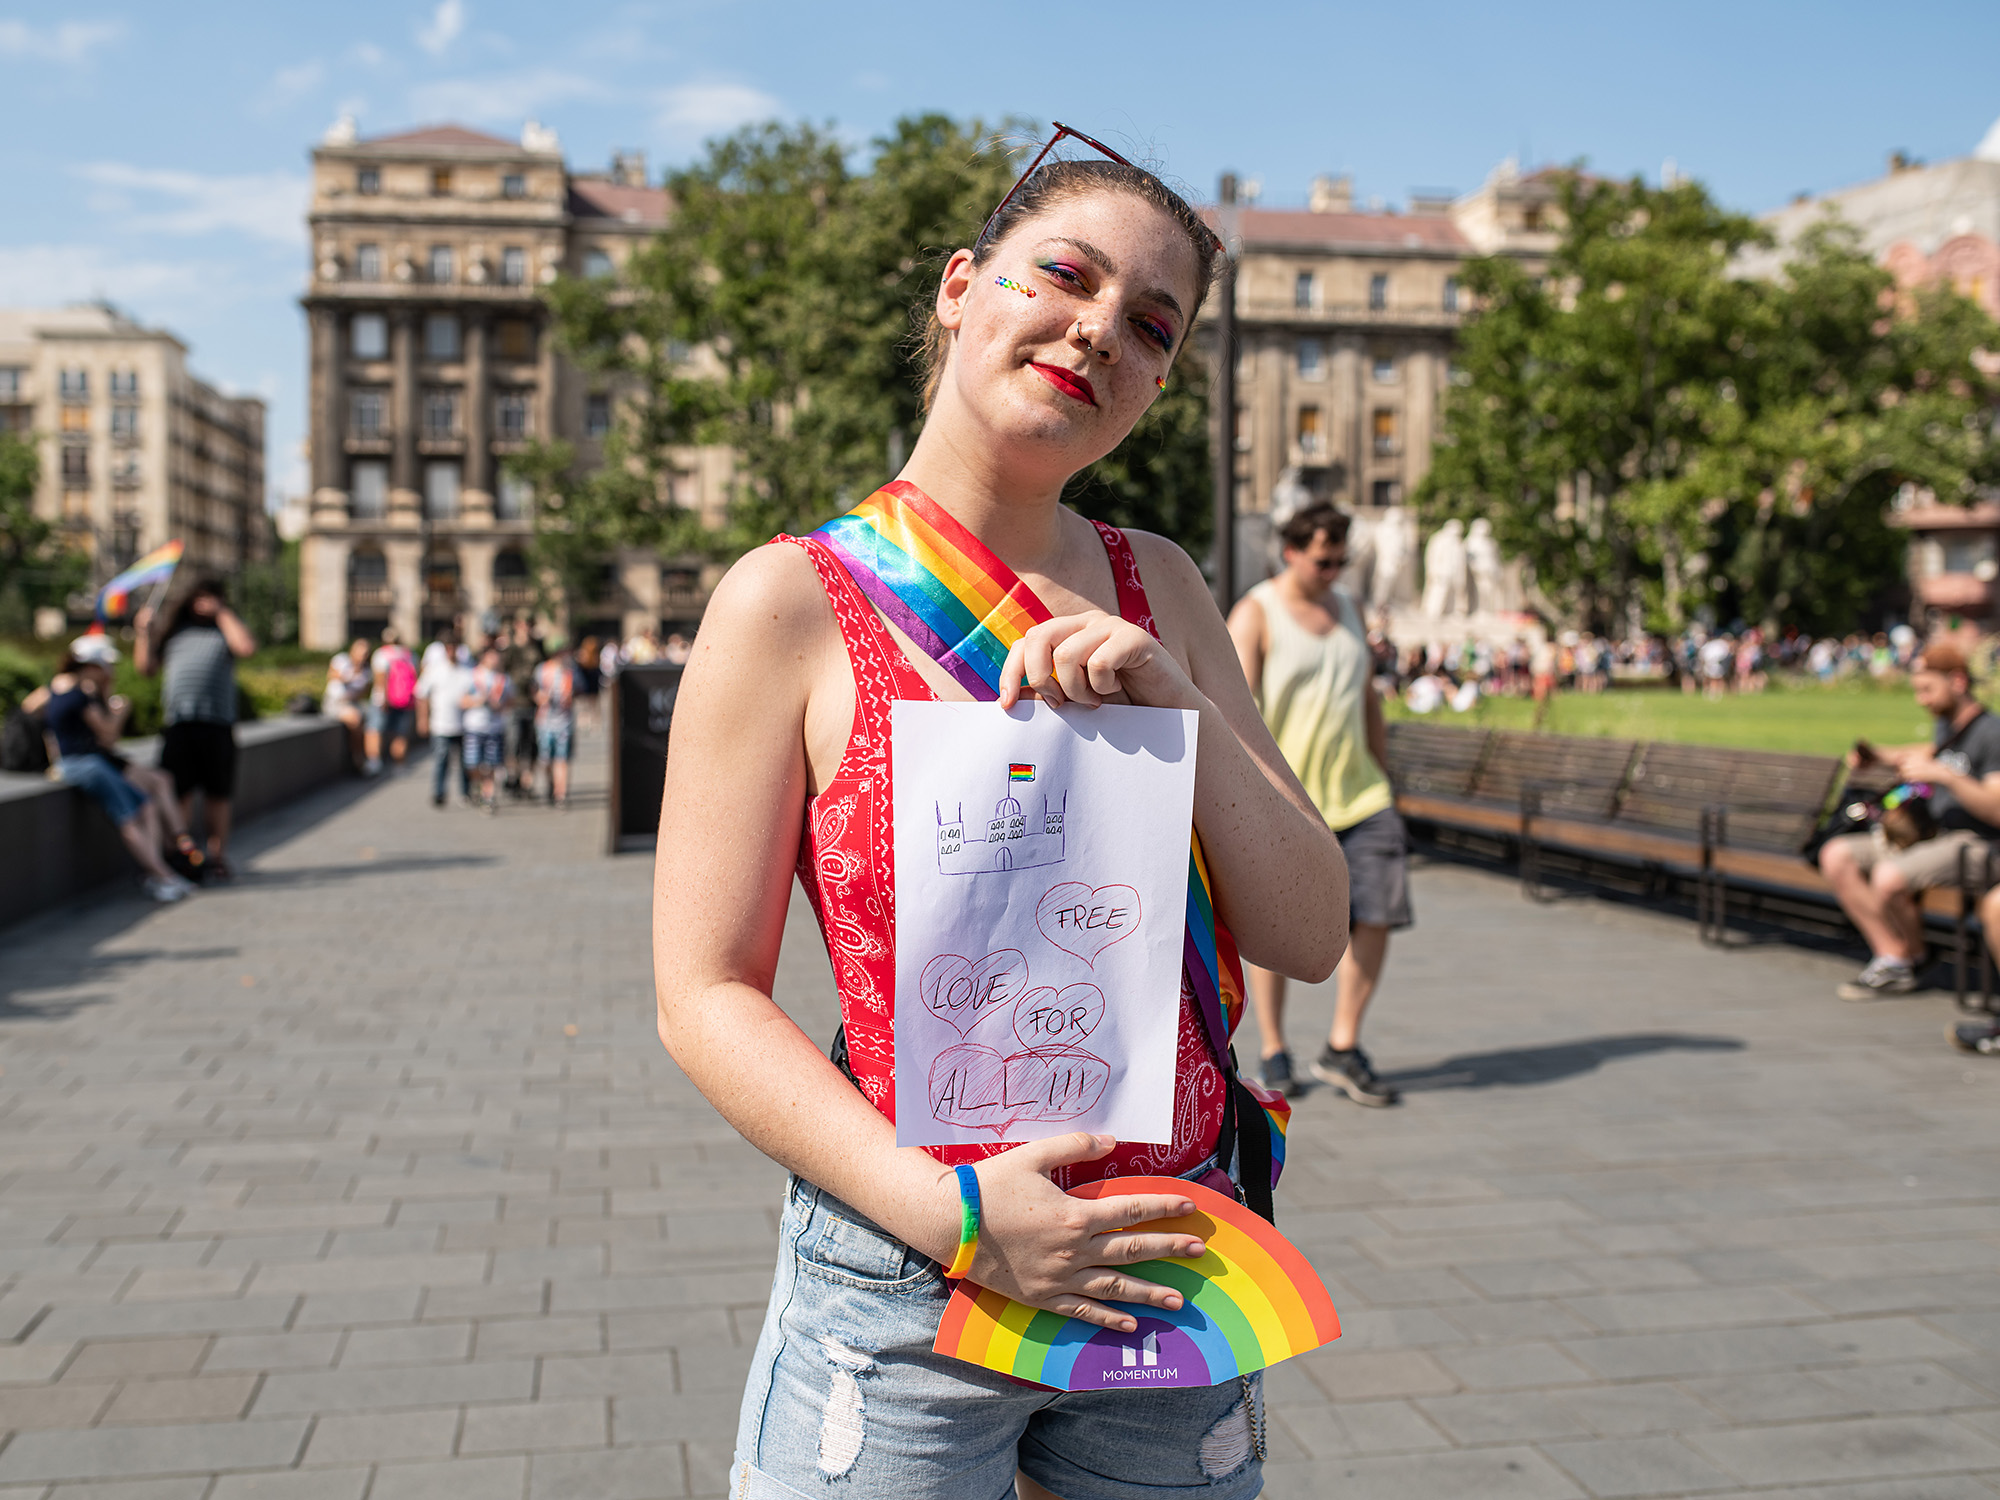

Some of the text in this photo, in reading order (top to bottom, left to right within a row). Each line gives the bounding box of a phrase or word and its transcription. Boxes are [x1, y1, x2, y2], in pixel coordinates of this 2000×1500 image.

[1055, 904, 1128, 931] FREE
[932, 973, 1011, 1010] LOVE
[1029, 1006, 1089, 1037] FOR
[1102, 1367, 1178, 1382] MOMENTUM
